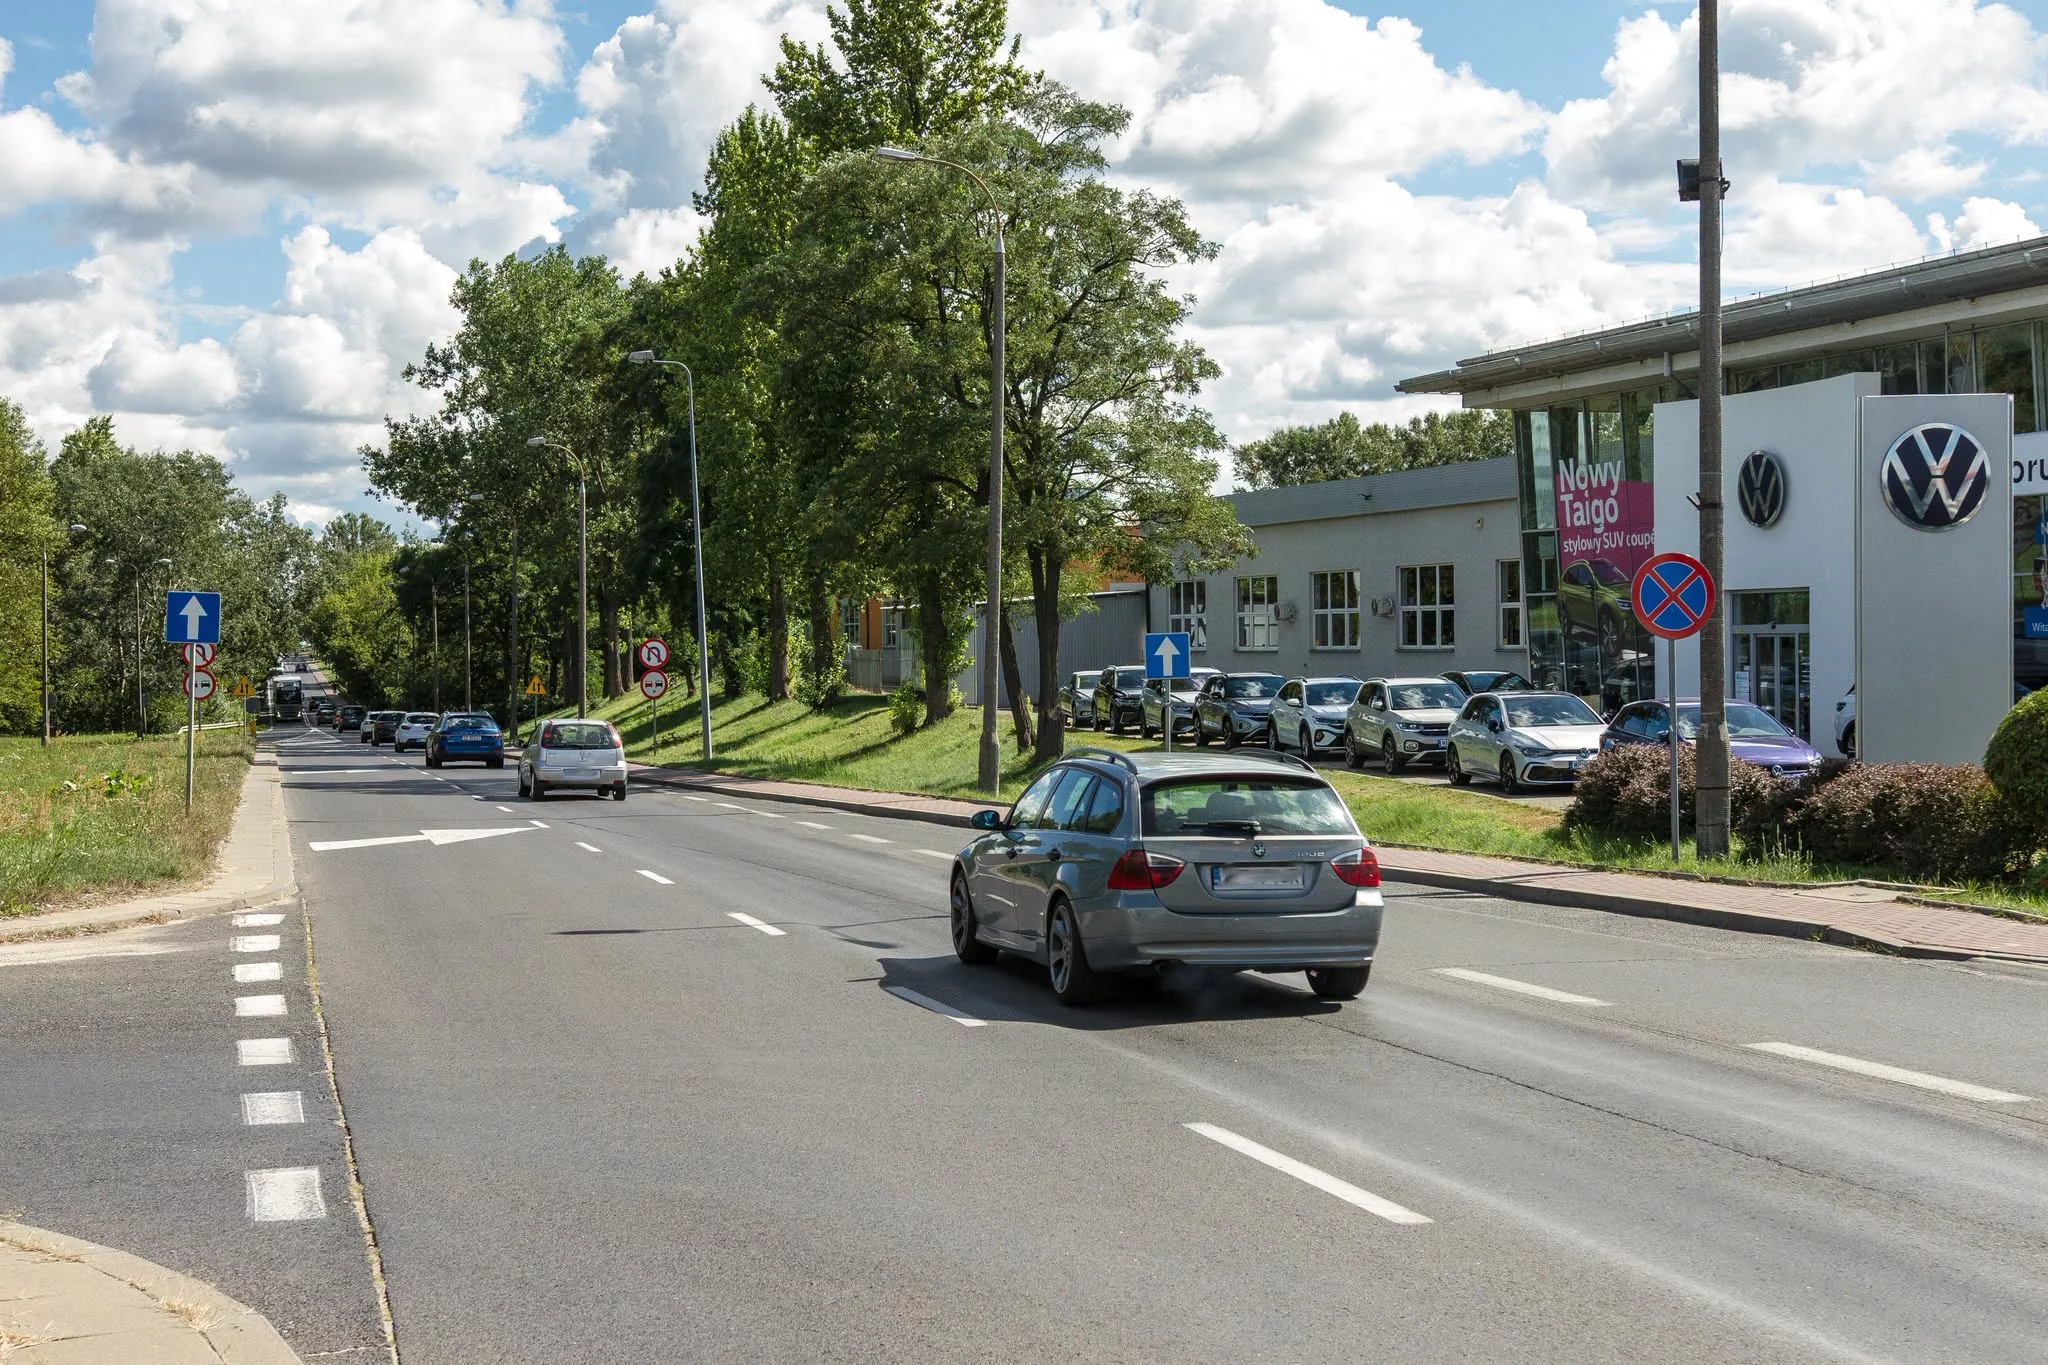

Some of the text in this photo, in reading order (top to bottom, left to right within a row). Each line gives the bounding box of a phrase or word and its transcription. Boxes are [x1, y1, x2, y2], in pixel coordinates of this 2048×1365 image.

[1559, 458, 1621, 496] Nowy
[1560, 490, 1619, 534] Taigo
[1563, 535, 1601, 556] stylowy
[1603, 531, 1624, 549] SUV
